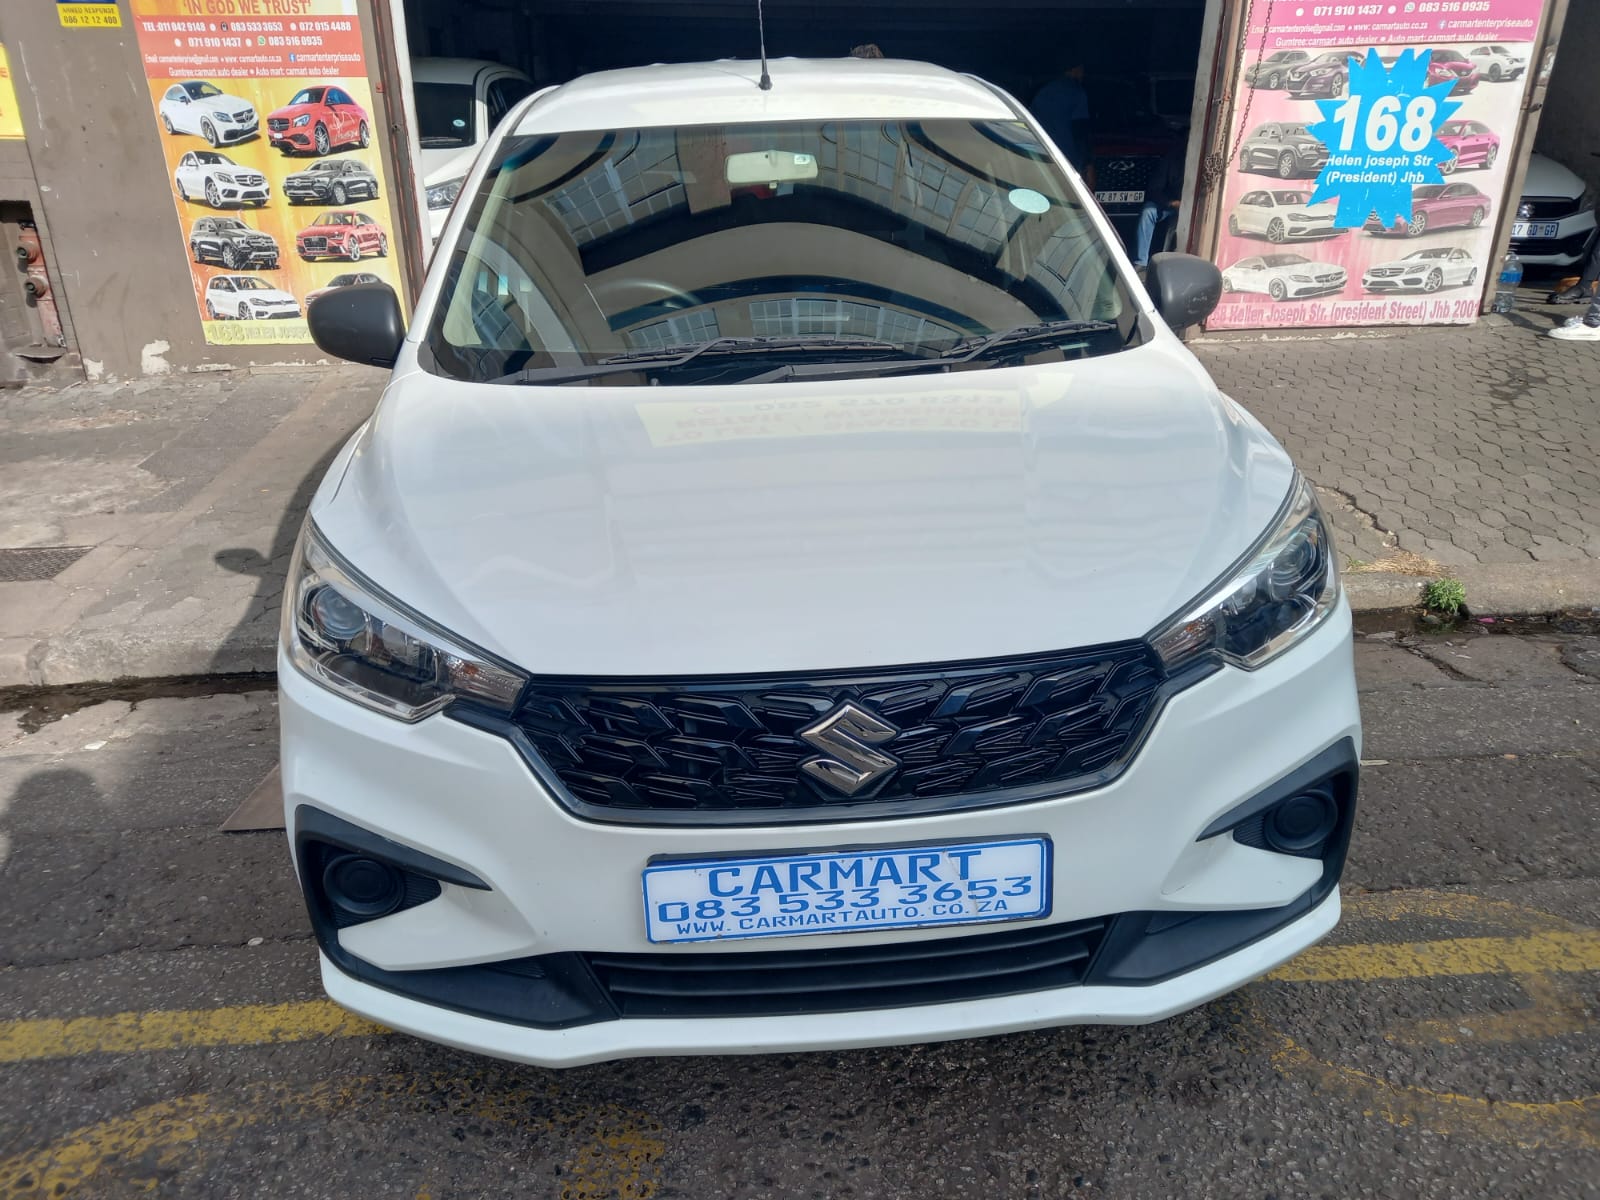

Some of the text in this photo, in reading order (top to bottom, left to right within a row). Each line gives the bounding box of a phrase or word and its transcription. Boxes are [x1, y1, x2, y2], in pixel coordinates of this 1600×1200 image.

[206, 0, 235, 14] GOD
[240, 0, 260, 14] WE
[1313, 1, 1490, 17] 071 910 1437 083 516 0935
[80, 16, 89, 24] 12
[92, 16, 101, 24] 12
[230, 22, 246, 32] 083
[247, 22, 262, 32] 533
[263, 22, 283, 32] 3653
[299, 22, 314, 31] 072
[315, 22, 330, 31] 015
[1448, 18, 1533, 29] carmartenterpriseauto
[188, 36, 323, 47] 071 910 1437 083 516 0935
[1339, 37, 1354, 45] auto
[1356, 36, 1378, 45] dealer
[1458, 32, 1474, 41] auto
[1475, 31, 1498, 41] dealer
[1333, 95, 1437, 152] 168
[1326, 155, 1362, 167] Helen
[1364, 154, 1410, 169] joseph
[1326, 171, 1424, 186] (President) Jhb
[1133, 192, 1143, 201] GP
[1544, 224, 1556, 235] GP
[1267, 303, 1307, 323] Joseph
[1330, 302, 1388, 322] (president
[1389, 300, 1428, 322] Street)
[1429, 300, 1451, 320] Jhb
[1453, 299, 1480, 319] 2001
[708, 850, 982, 897] CARMART
[657, 875, 1032, 923] 083 533 3653
